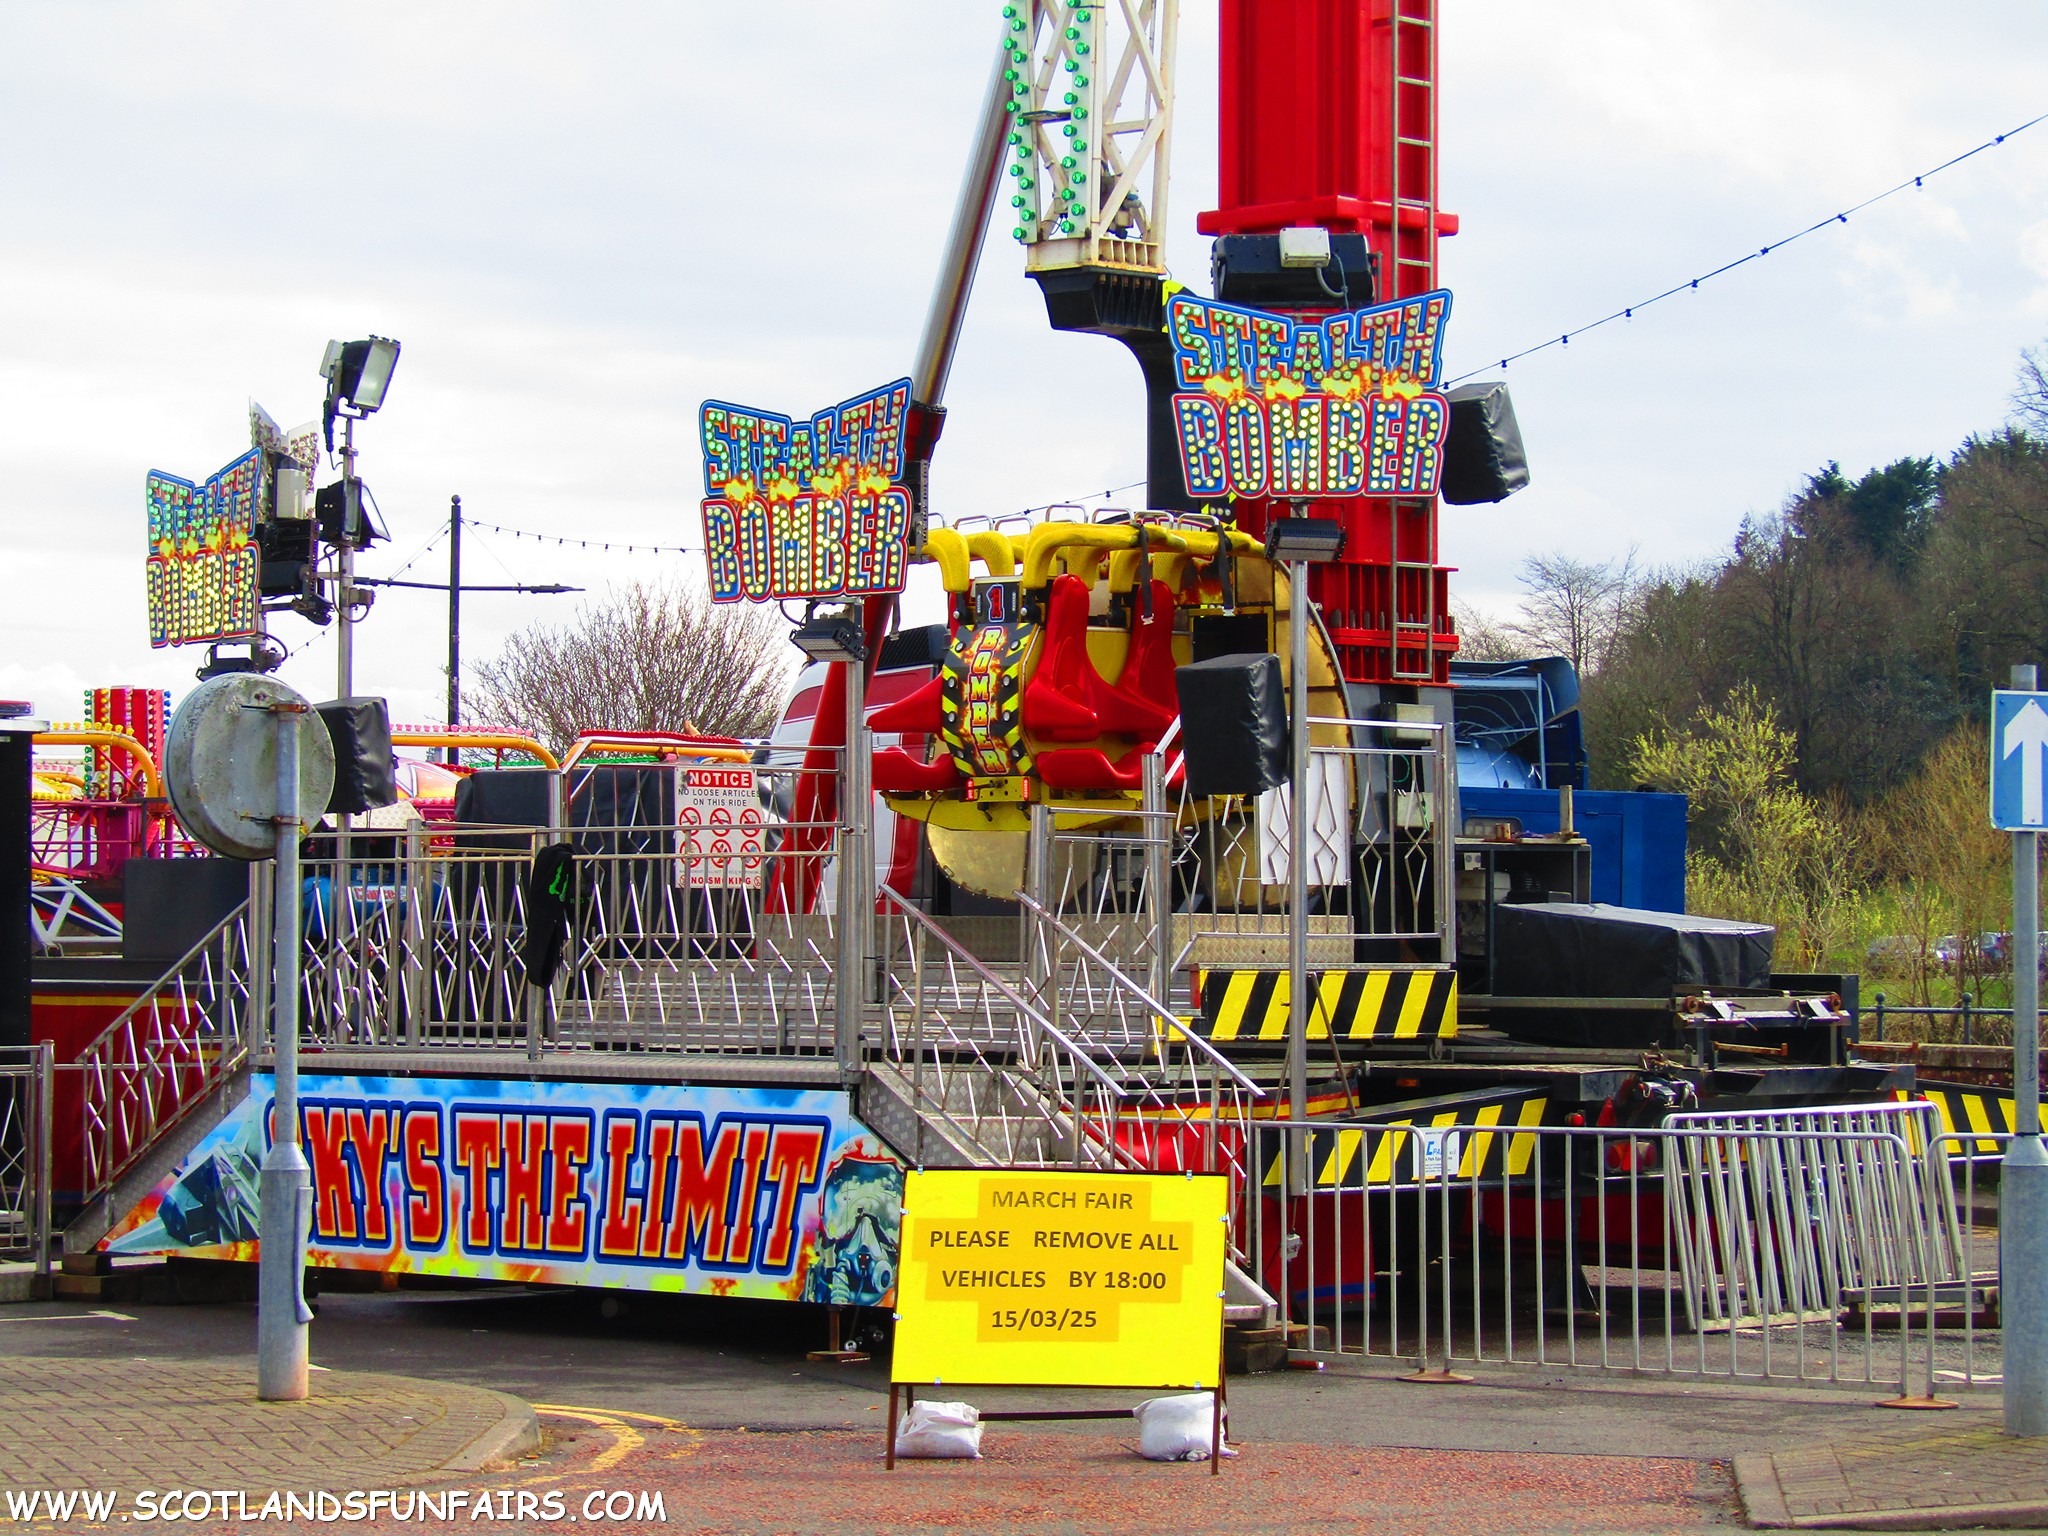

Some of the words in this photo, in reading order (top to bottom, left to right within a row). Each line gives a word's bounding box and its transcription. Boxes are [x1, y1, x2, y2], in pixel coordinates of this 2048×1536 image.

[1171, 296, 1446, 386] STEALTH
[703, 386, 909, 492] STEALTH
[1174, 395, 1446, 495] BOMBER
[148, 450, 260, 551] STEALTH
[704, 492, 908, 600] BOMBER
[148, 546, 260, 644] BOMBER
[987, 585, 1005, 622] 1
[970, 627, 1007, 774] BOMBER
[689, 772, 750, 786] NOTICE
[692, 789, 720, 797] LOOSE
[693, 798, 704, 806] ON
[708, 798, 725, 806] THIS
[728, 799, 747, 807] RIDE
[691, 877, 704, 885] NO
[708, 877, 751, 885] SMKING
[265, 1106, 444, 1245] KY'S
[456, 1110, 592, 1254] THE
[600, 1115, 826, 1268] LIMIT
[992, 1191, 1077, 1209] MARCH
[1084, 1192, 1134, 1210] FAIR
[929, 1230, 1010, 1248] PLEASE
[1033, 1231, 1133, 1250] REMOVE
[1138, 1233, 1180, 1251] ALL
[941, 1270, 1047, 1289] VEHICLES
[1069, 1271, 1098, 1289] BY
[1103, 1271, 1167, 1290] 18:00
[991, 1308, 1098, 1331] 15/03/25
